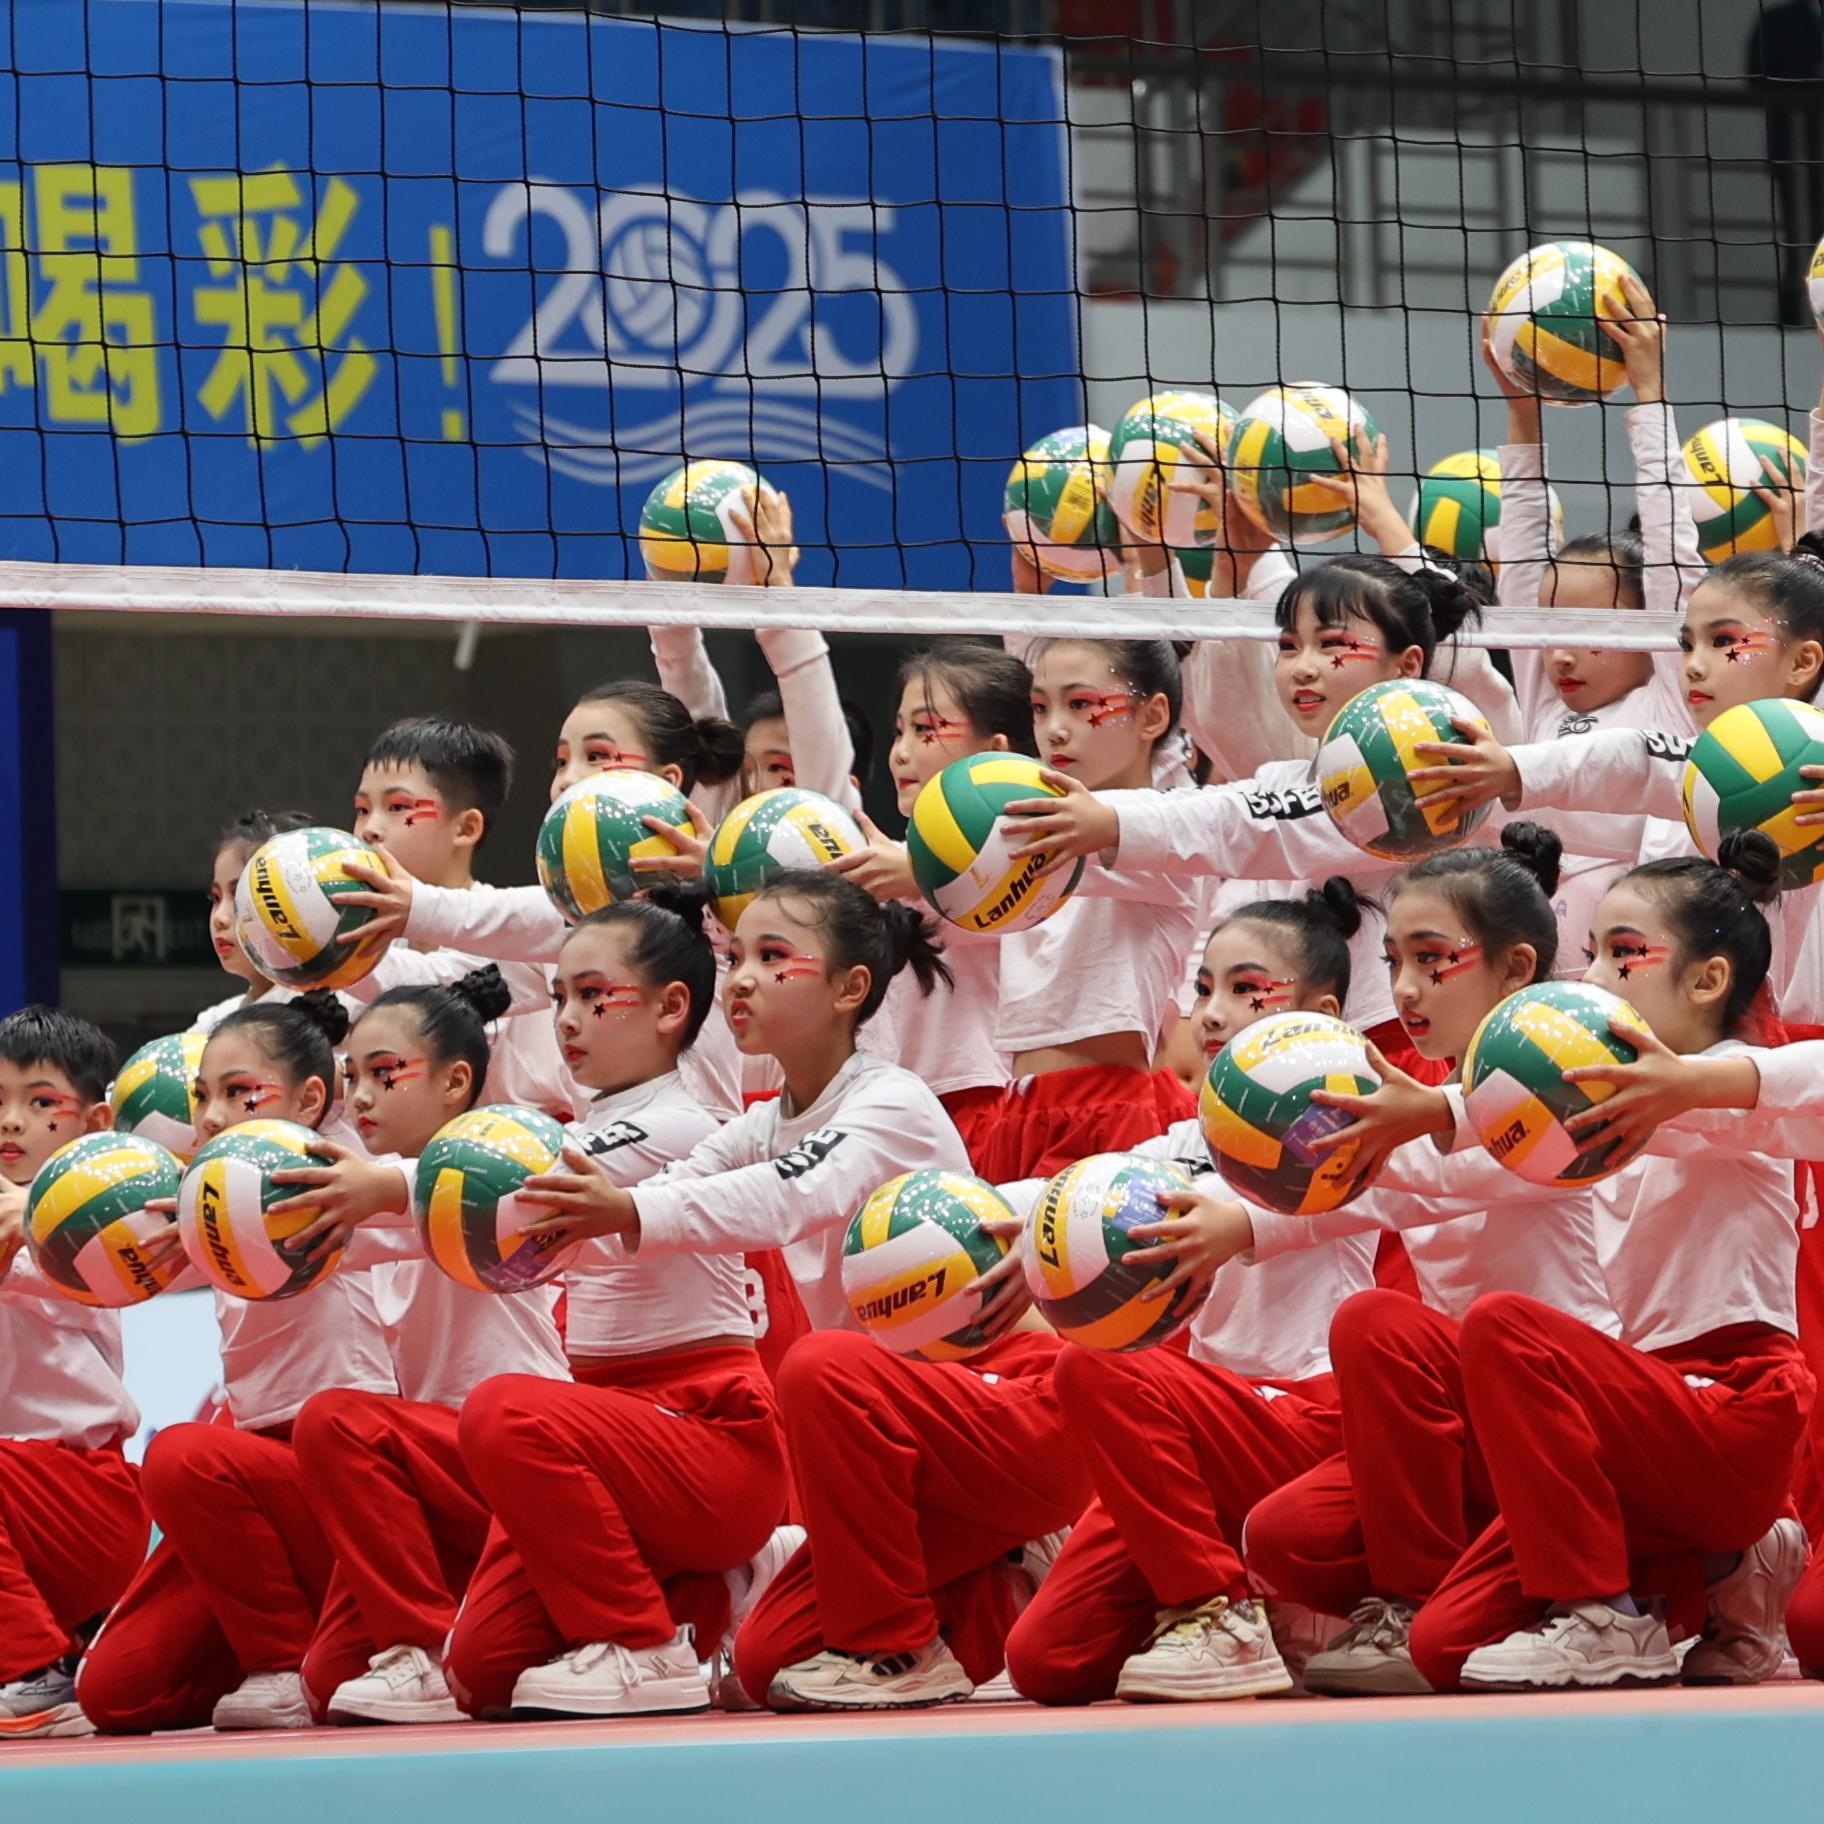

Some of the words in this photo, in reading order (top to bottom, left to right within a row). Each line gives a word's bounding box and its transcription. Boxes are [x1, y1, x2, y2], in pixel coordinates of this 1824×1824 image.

[484, 176, 920, 402] 2025
[203, 1180, 247, 1288] Lanhua
[856, 1267, 948, 1323] Lanhua
